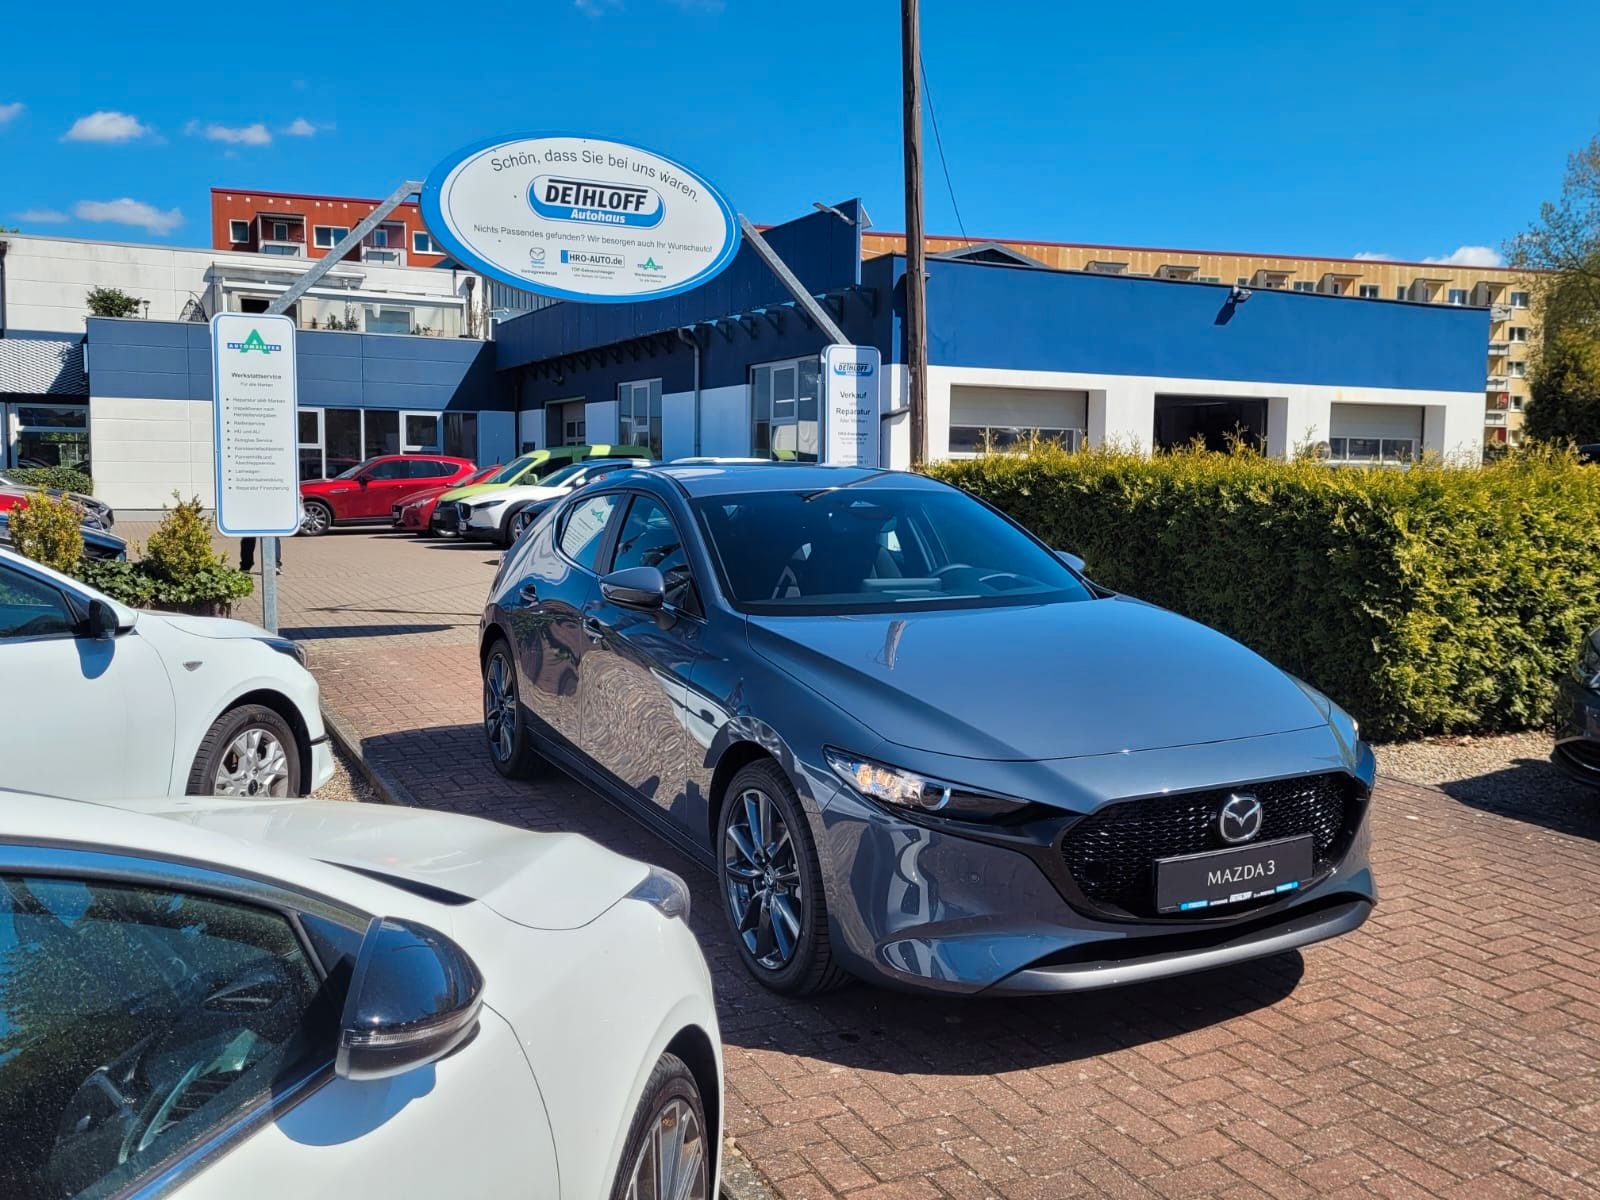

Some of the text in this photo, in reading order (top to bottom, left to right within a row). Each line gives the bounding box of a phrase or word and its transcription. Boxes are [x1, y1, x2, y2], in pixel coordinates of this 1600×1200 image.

[491, 149, 697, 202] Schön, dass Sie bei uns waren.
[545, 179, 648, 212] DETHLOFF
[571, 209, 625, 223] Autohaus
[473, 224, 499, 233] Nichts
[501, 227, 543, 238] Passendes
[545, 231, 585, 242] gefunden?
[587, 235, 600, 243] Wir
[601, 236, 635, 246] besorgen
[637, 240, 654, 248] auch
[667, 242, 712, 253] Wunschauto!
[569, 253, 623, 265] HRO-AUTO.de
[840, 391, 867, 399] Verkauf
[835, 407, 871, 416] Reparatur
[1207, 860, 1275, 886] MAZDA 3
